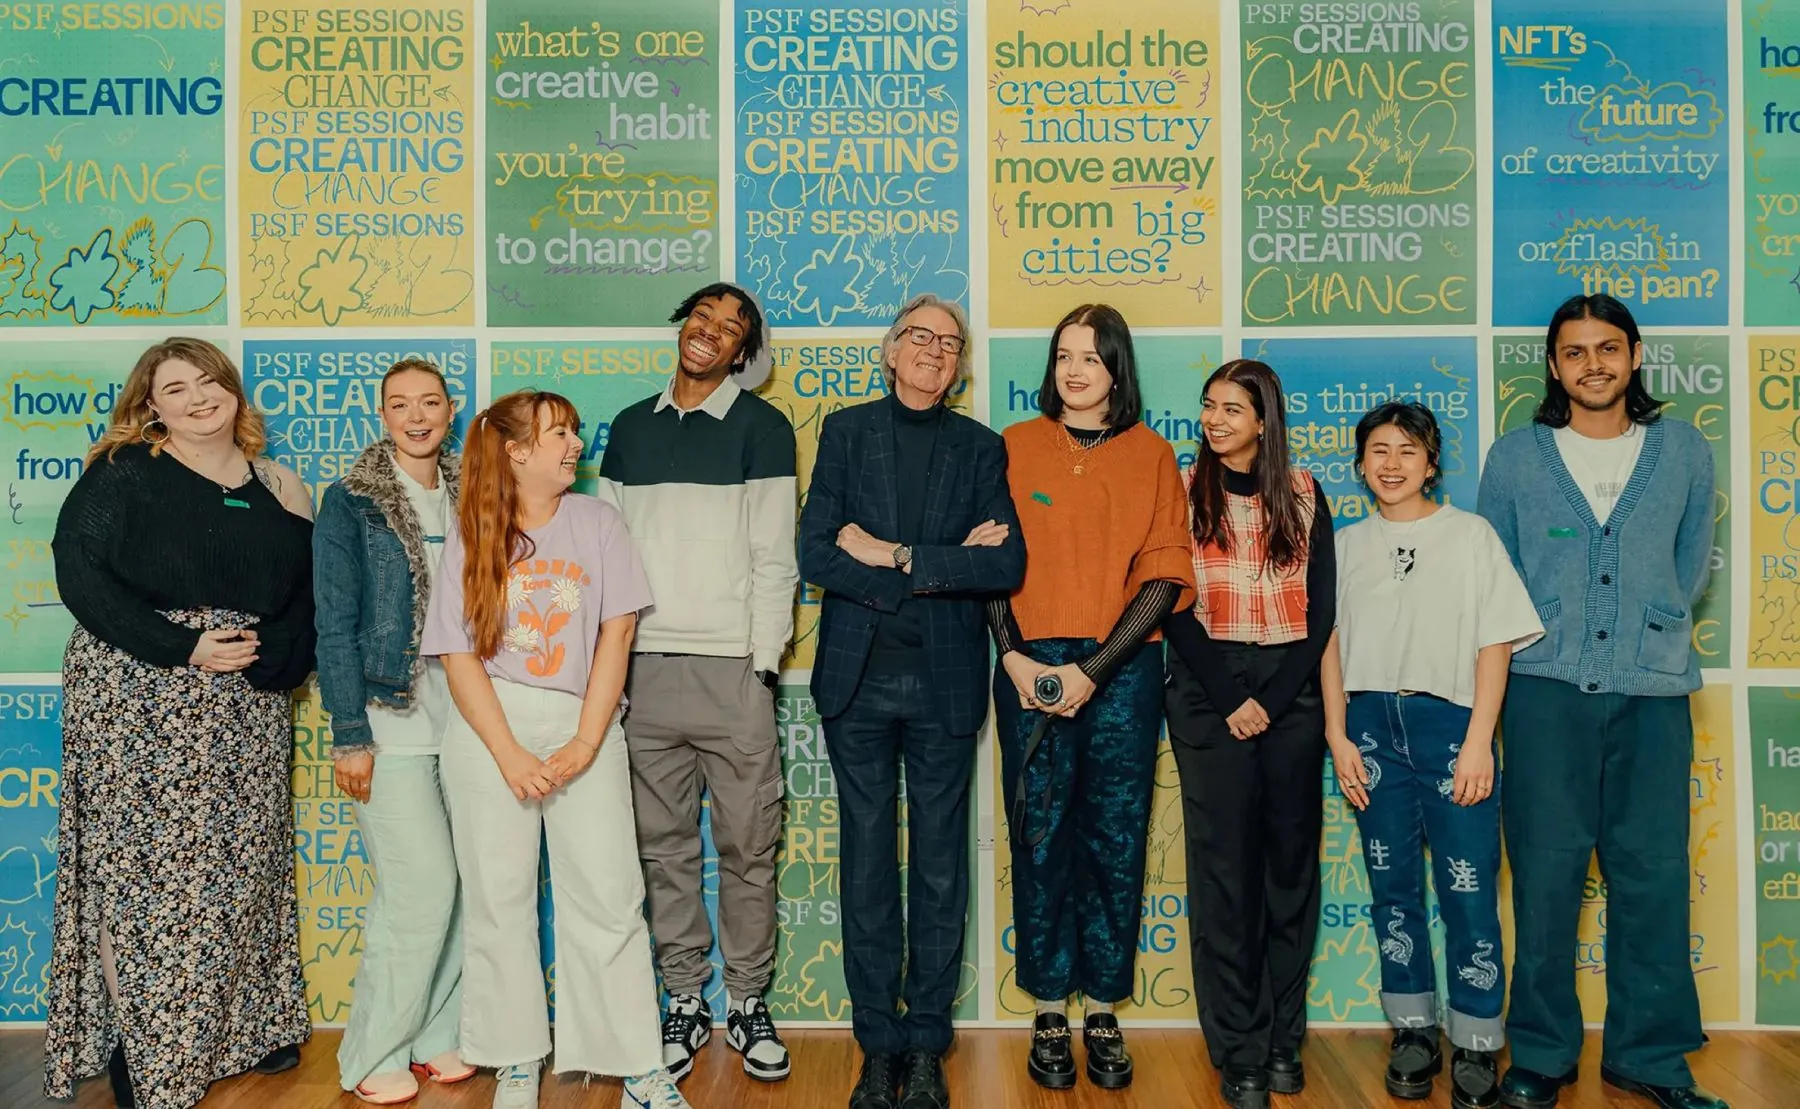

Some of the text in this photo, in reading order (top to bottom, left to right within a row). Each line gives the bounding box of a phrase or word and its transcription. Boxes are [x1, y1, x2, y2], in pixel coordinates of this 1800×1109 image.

[62, 4, 224, 30] SESSIONS
[251, 9, 464, 33] PSF SESSIONS
[745, 9, 957, 33] PSF SESSIONS
[1246, 2, 1421, 24] PSF SESSIONS
[495, 22, 704, 57] what's one
[994, 29, 1208, 67] should the
[1293, 22, 1469, 53] CREATING
[1500, 25, 1587, 55] NFT's
[1760, 37, 1800, 68] ho
[251, 36, 464, 72] CREATING
[745, 36, 958, 72] CREATING
[284, 74, 431, 108] CHANGE
[495, 62, 659, 98] creative
[778, 74, 925, 108] CHANGE
[997, 70, 1175, 105] creative
[1246, 53, 1468, 108] CHANGE
[1540, 77, 1595, 105] the
[0, 78, 223, 115] CREATING
[1600, 96, 1698, 126] future
[251, 111, 464, 134] PSF SESSIONS
[610, 103, 711, 140] habit
[745, 111, 958, 135] PSF SESSIONS
[1020, 109, 1212, 150] industry
[1763, 102, 1800, 133] fro
[249, 137, 464, 173] CREATING
[495, 144, 625, 185] you're
[745, 138, 959, 173] CREATING
[1501, 147, 1720, 180] of creativity
[0, 154, 224, 211] CHANGE
[995, 156, 1214, 189] move away
[272, 168, 441, 209] CHANGE
[566, 180, 711, 223] trying
[769, 169, 936, 210] CHANGE
[745, 210, 959, 235] PSF SESSIONS
[1016, 191, 1206, 244] from big
[1255, 203, 1470, 229] PSF SESSIONS
[1757, 193, 1800, 222] yo
[250, 212, 464, 237] PSF SESSIONS
[496, 228, 712, 273] to change?
[1022, 239, 1172, 274] cities?
[1248, 233, 1422, 263] CREATING
[1518, 233, 1701, 262] or flash in
[1244, 266, 1467, 322] CHANGE
[1581, 269, 1720, 304] the pan?
[254, 352, 467, 377] PSF SESSS
[491, 346, 677, 376] PSF SESSIO
[800, 346, 882, 366] SESSIO
[1499, 343, 1547, 364] PSF
[1759, 348, 1796, 371] PS
[794, 368, 890, 398] CREA
[1640, 364, 1724, 394] TING
[14, 384, 87, 414] how
[253, 379, 467, 415] CREATG
[287, 418, 385, 452] CHAN
[1760, 452, 1796, 474] PS
[1761, 556, 1798, 579] PS
[1761, 839, 1789, 862] or
